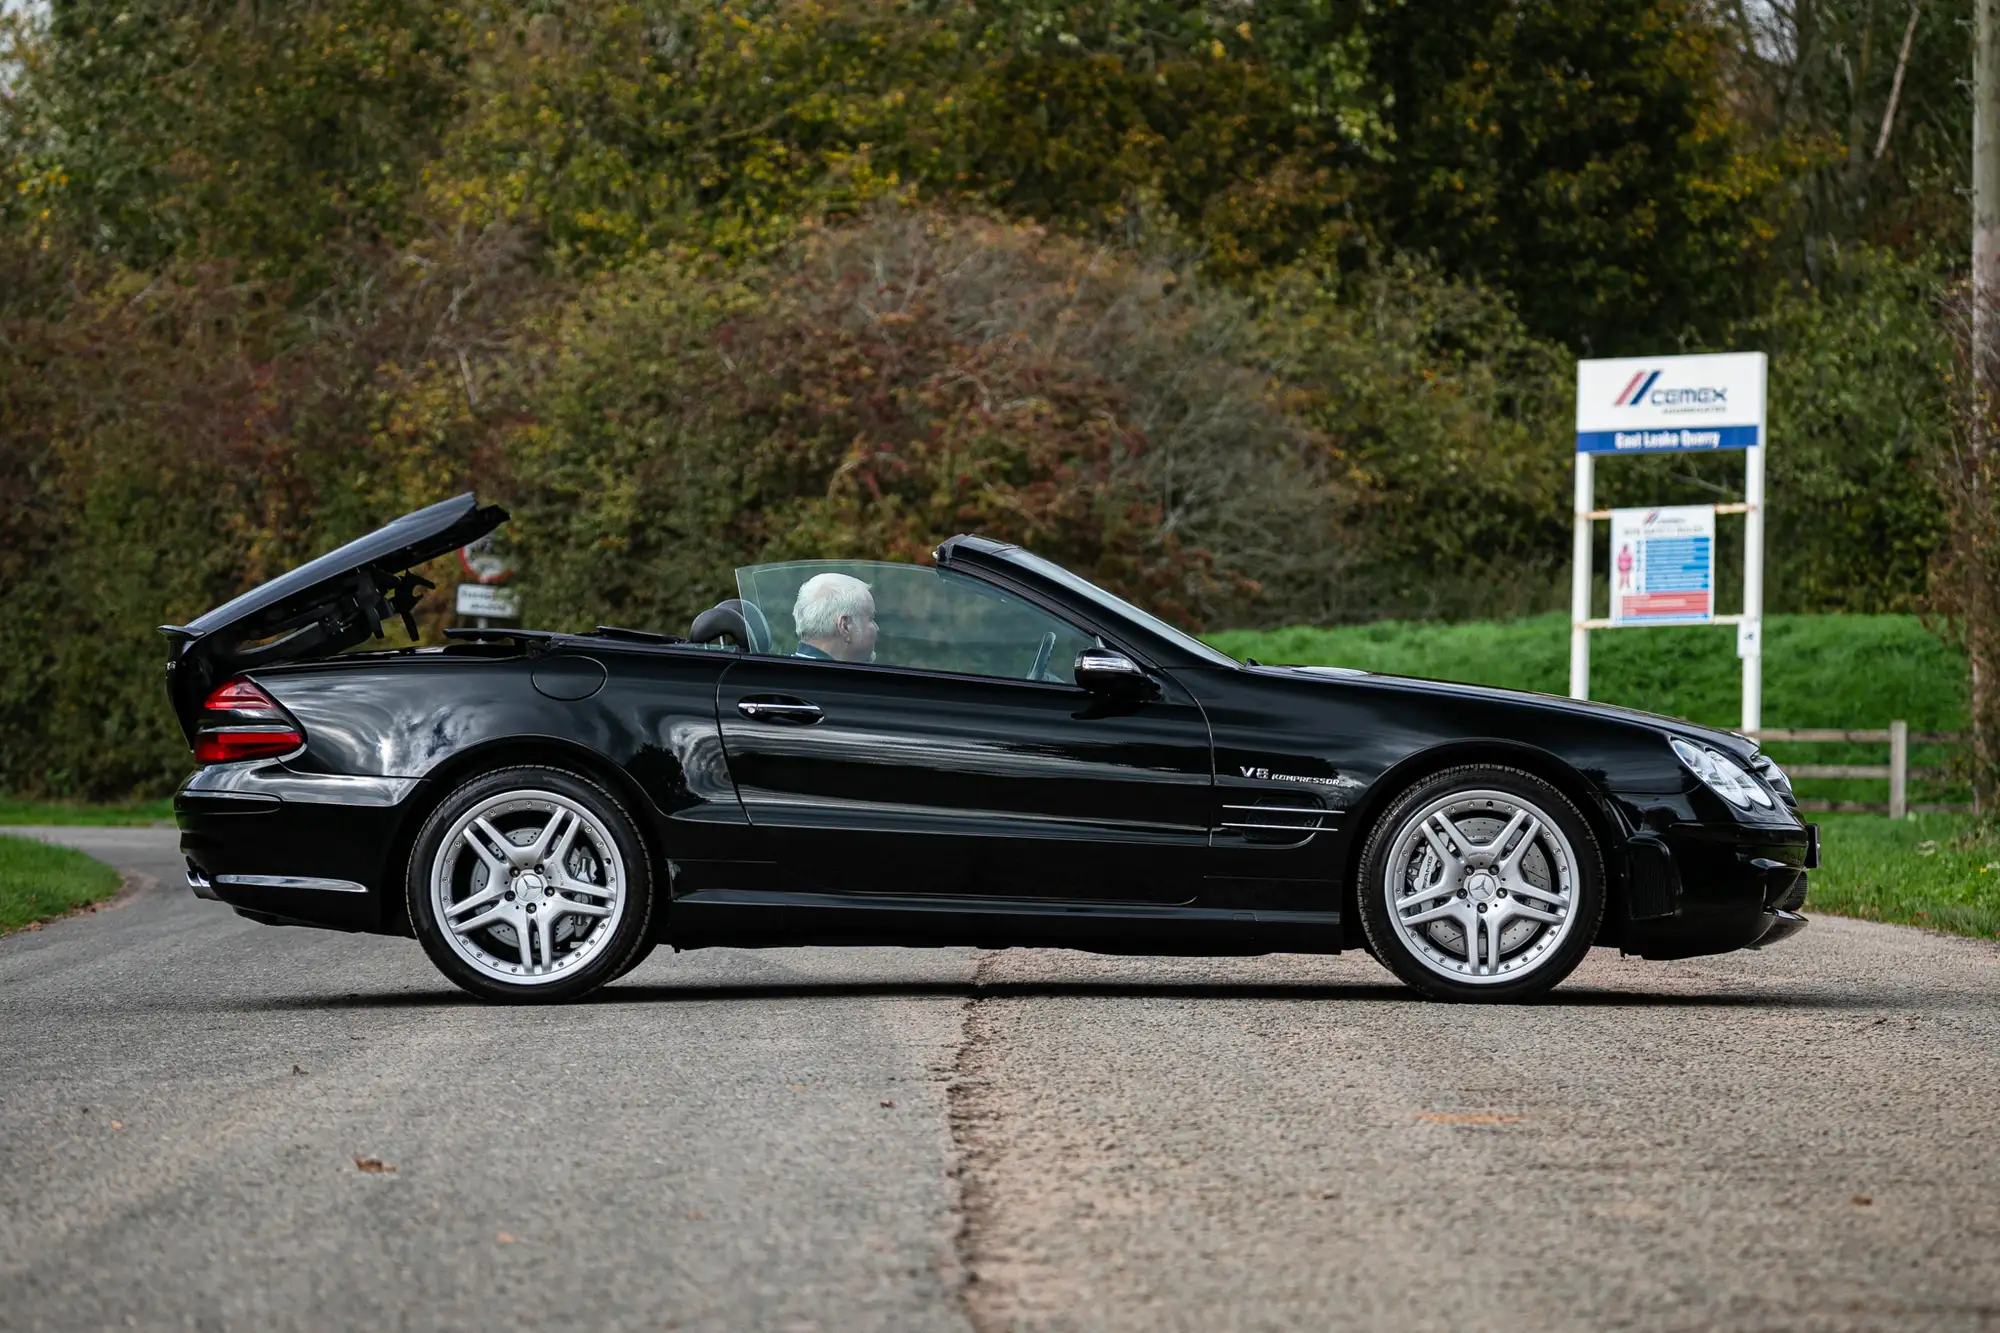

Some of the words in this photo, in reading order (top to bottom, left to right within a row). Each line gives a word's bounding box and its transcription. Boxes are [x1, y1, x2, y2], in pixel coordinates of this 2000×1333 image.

[1680, 430, 1721, 449] Quarry
[1240, 766, 1269, 780] V8
[1271, 774, 1340, 785] KOMPRESSOR
